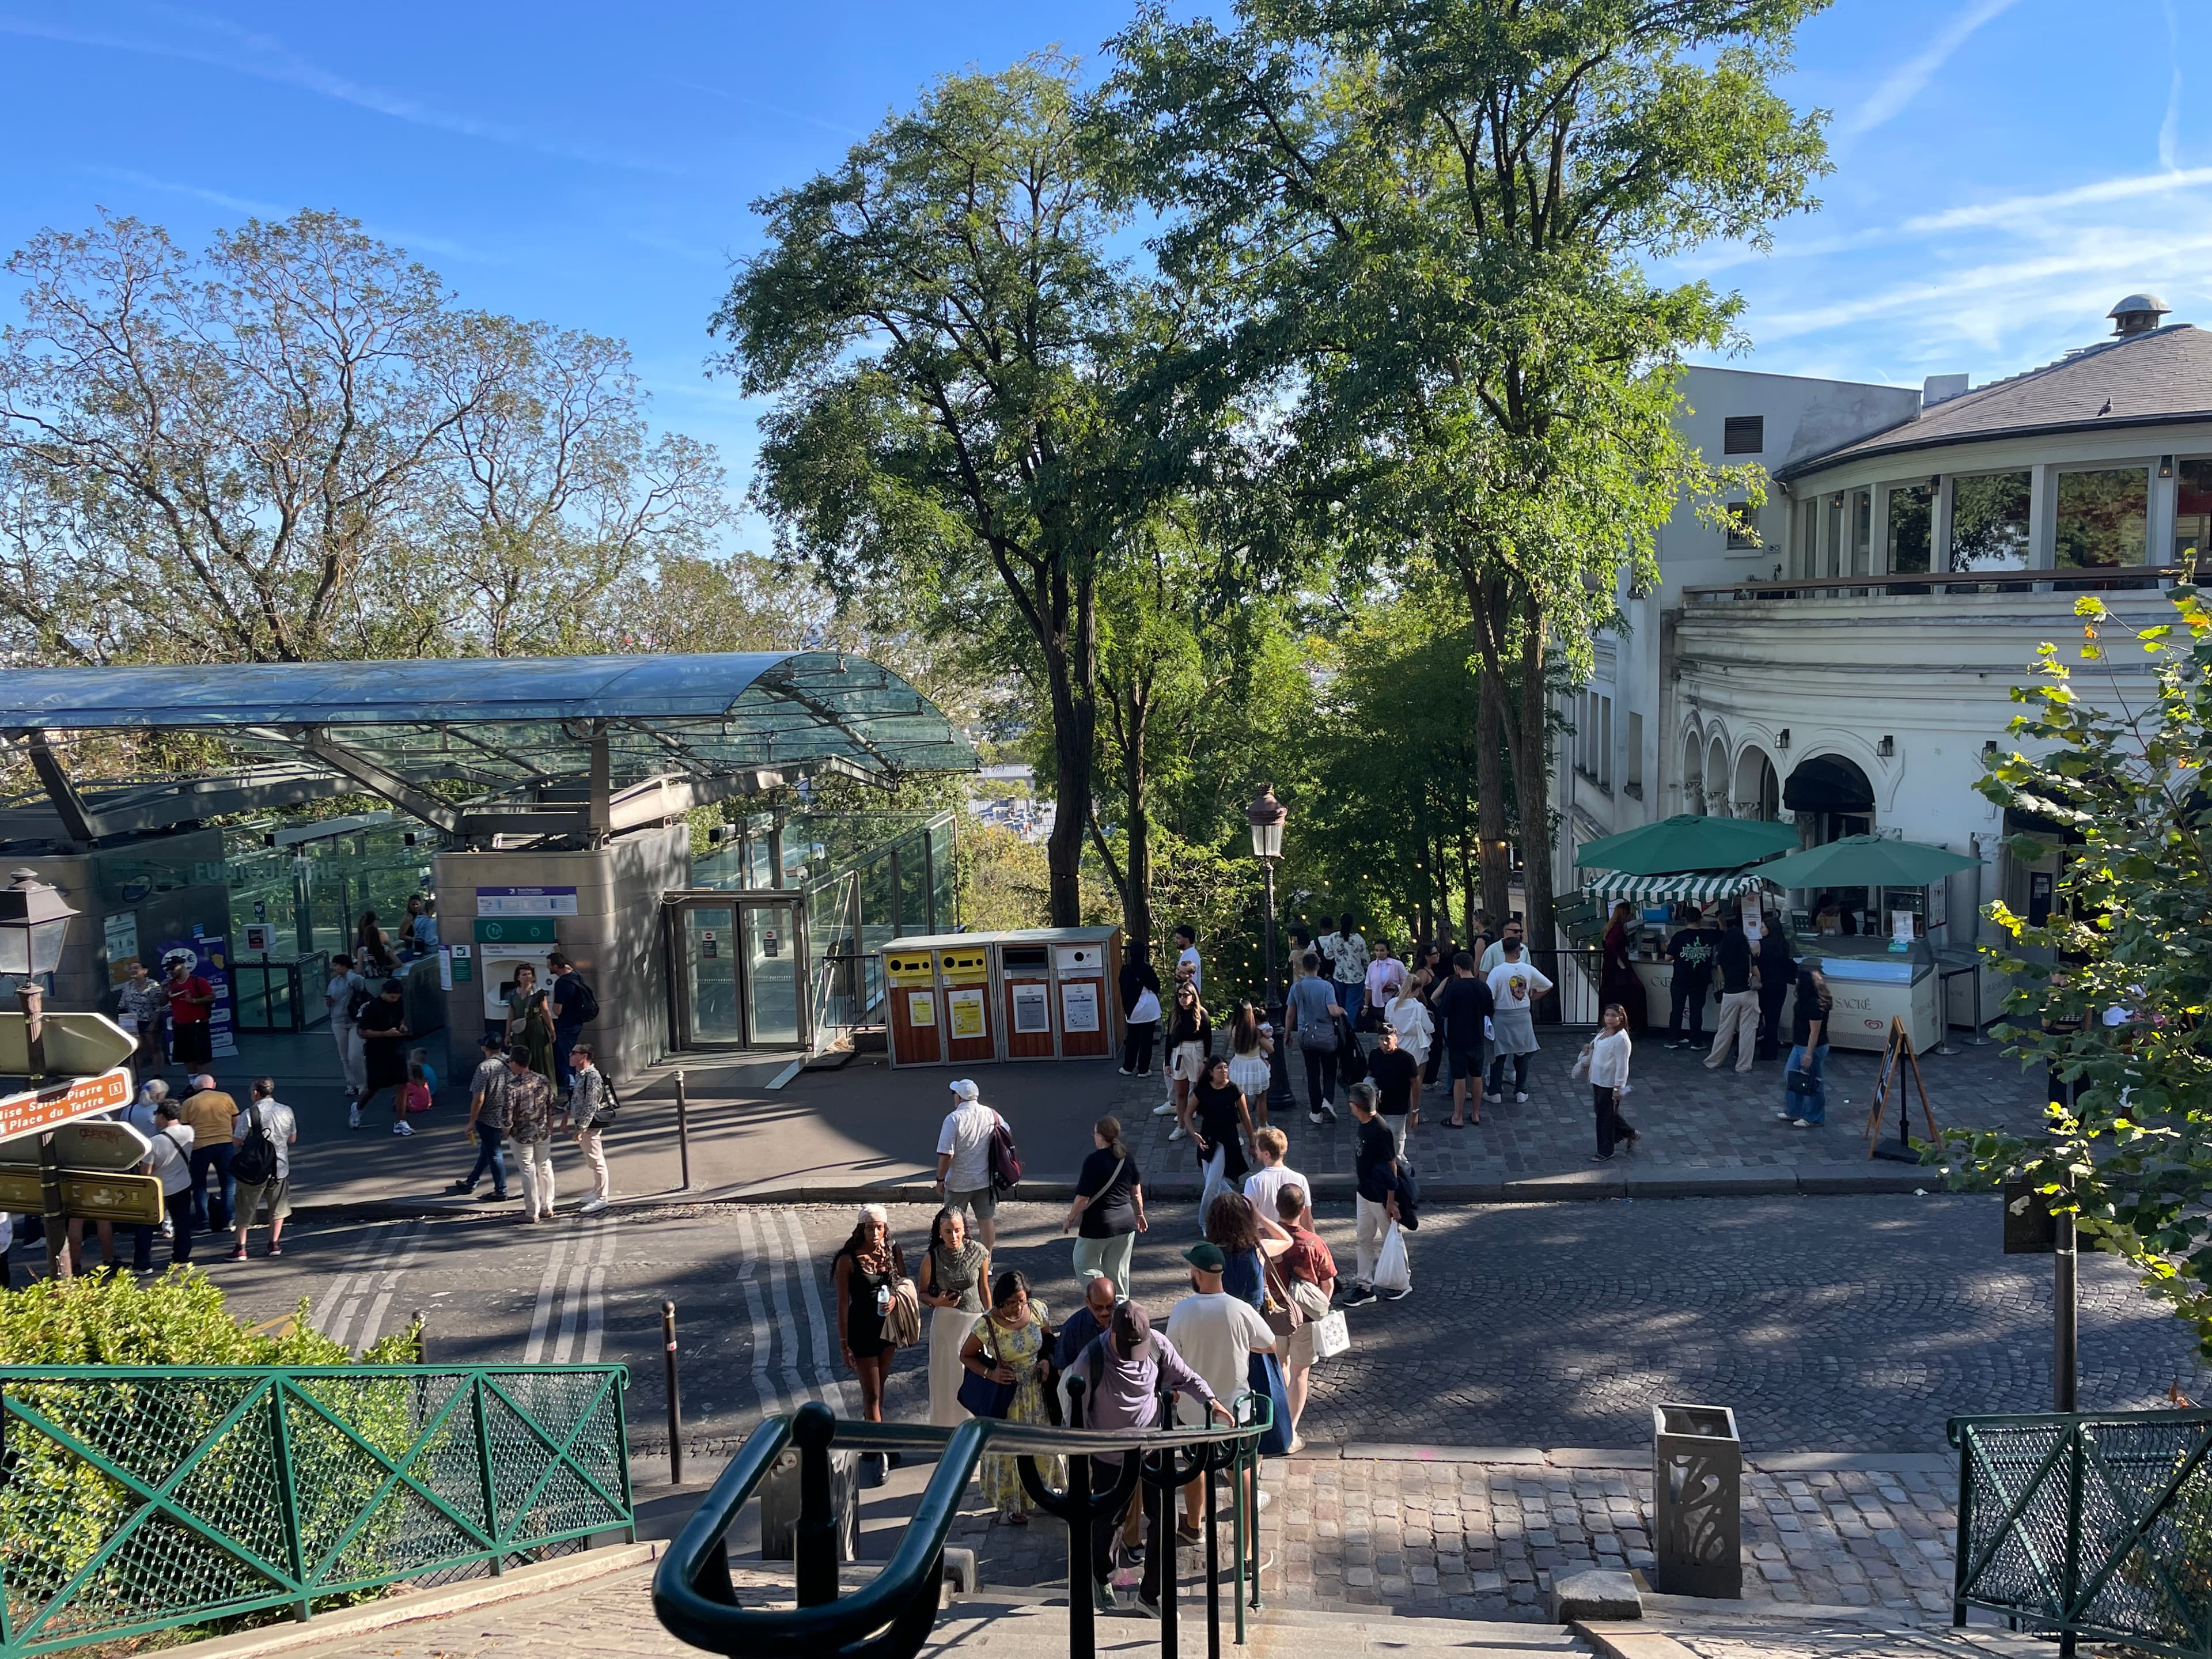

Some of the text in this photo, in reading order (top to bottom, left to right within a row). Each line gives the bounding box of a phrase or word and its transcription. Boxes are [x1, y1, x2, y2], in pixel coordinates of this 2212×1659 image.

[1835, 998, 1872, 1010] SACRÉ
[29, 1084, 103, 1112] Saint-Pierre
[9, 1096, 105, 1131] Place du Tertre
